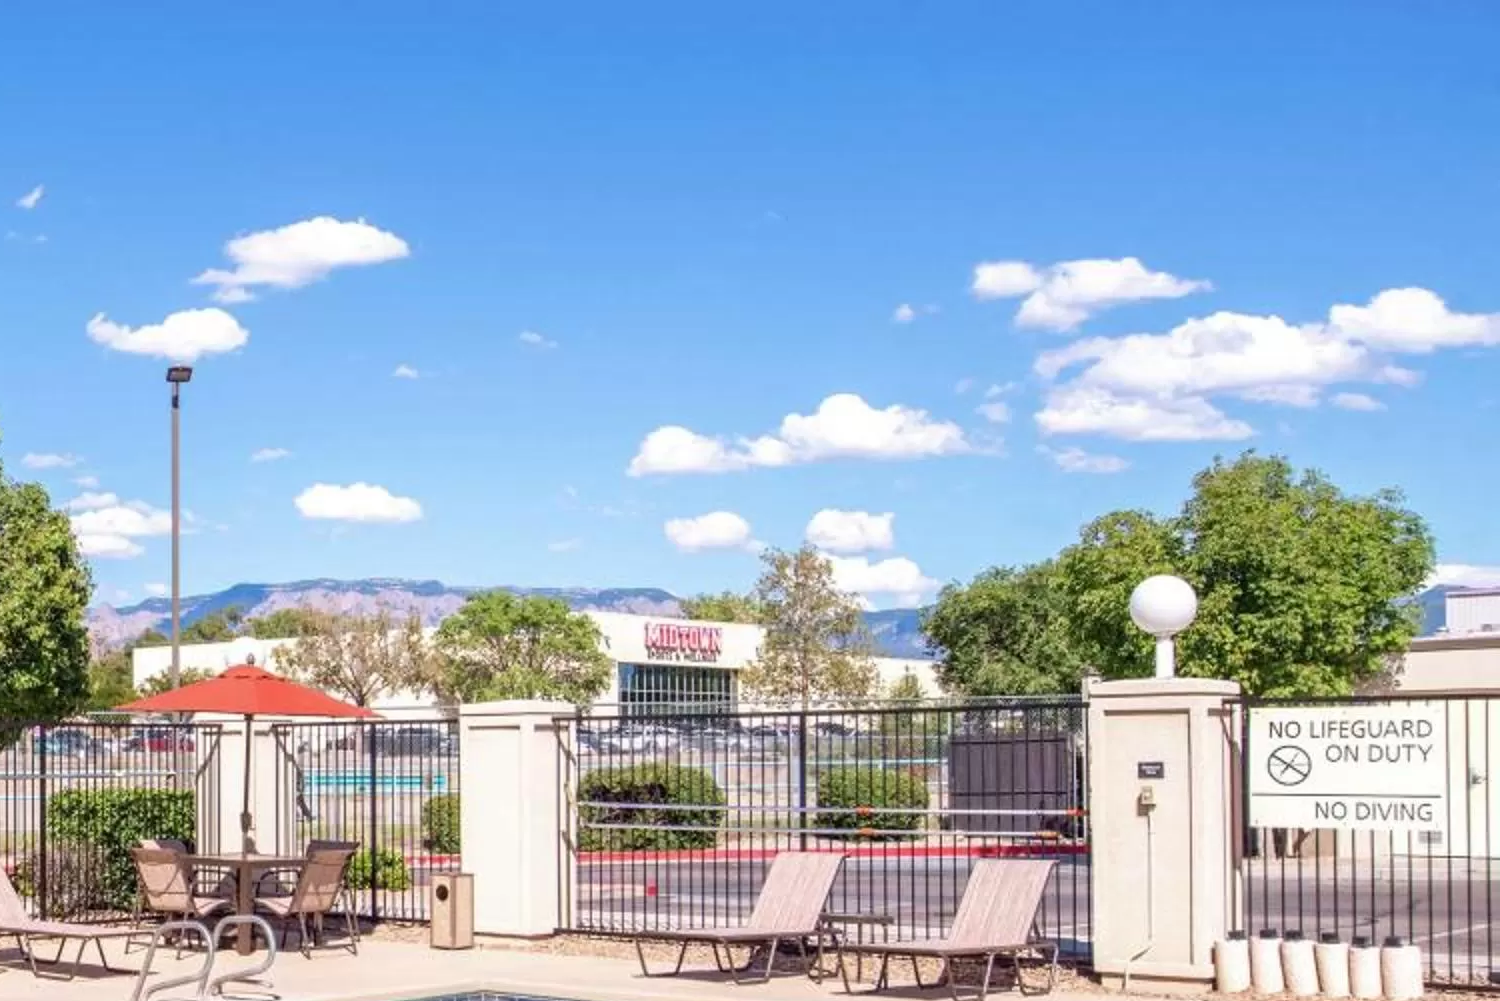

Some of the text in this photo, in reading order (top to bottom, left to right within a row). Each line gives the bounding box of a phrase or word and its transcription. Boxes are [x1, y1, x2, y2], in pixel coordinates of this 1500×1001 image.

[644, 622, 722, 653] MIDTOWN
[1269, 720, 1432, 738] NO LIFEGUARD
[1326, 744, 1432, 762] ON DUTY
[1316, 802, 1432, 821] NO DIVING
